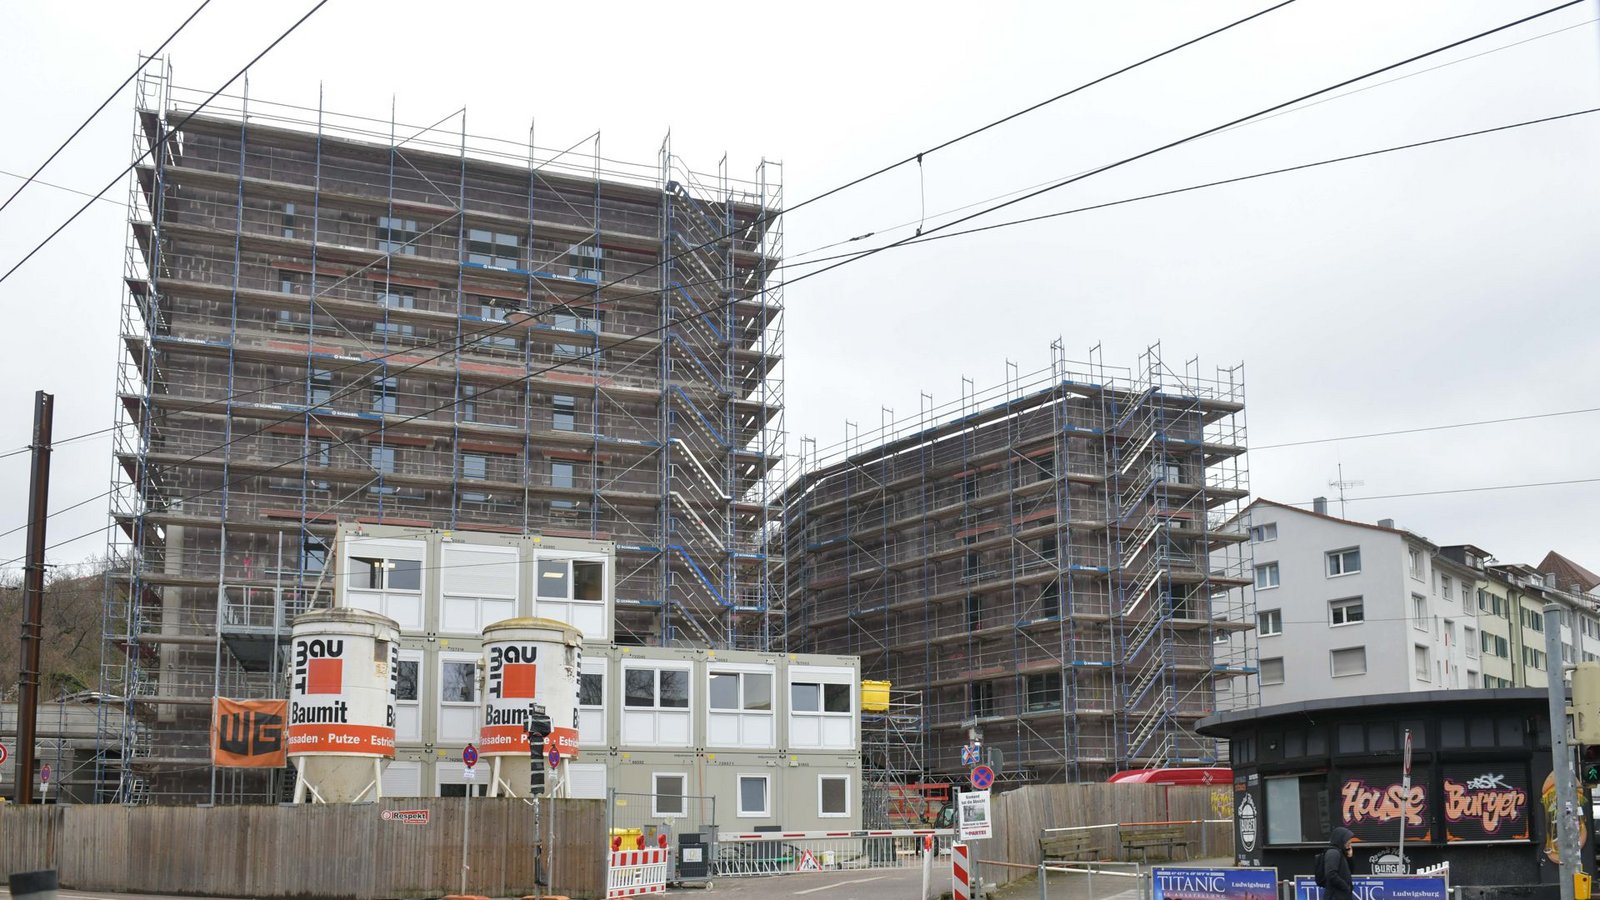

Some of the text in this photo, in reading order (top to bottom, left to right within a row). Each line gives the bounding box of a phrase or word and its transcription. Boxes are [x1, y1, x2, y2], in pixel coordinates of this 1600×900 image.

[291, 700, 348, 723] Baumit
[288, 733, 318, 745] assaden
[328, 732, 361, 744] Putze
[393, 811, 425, 819] Respekt
[1157, 876, 1226, 893] TITANIC
[1231, 881, 1271, 889] Ludwigsburg
[1301, 886, 1385, 900] TINIC
[1392, 890, 1440, 898] Ludwigsburg
